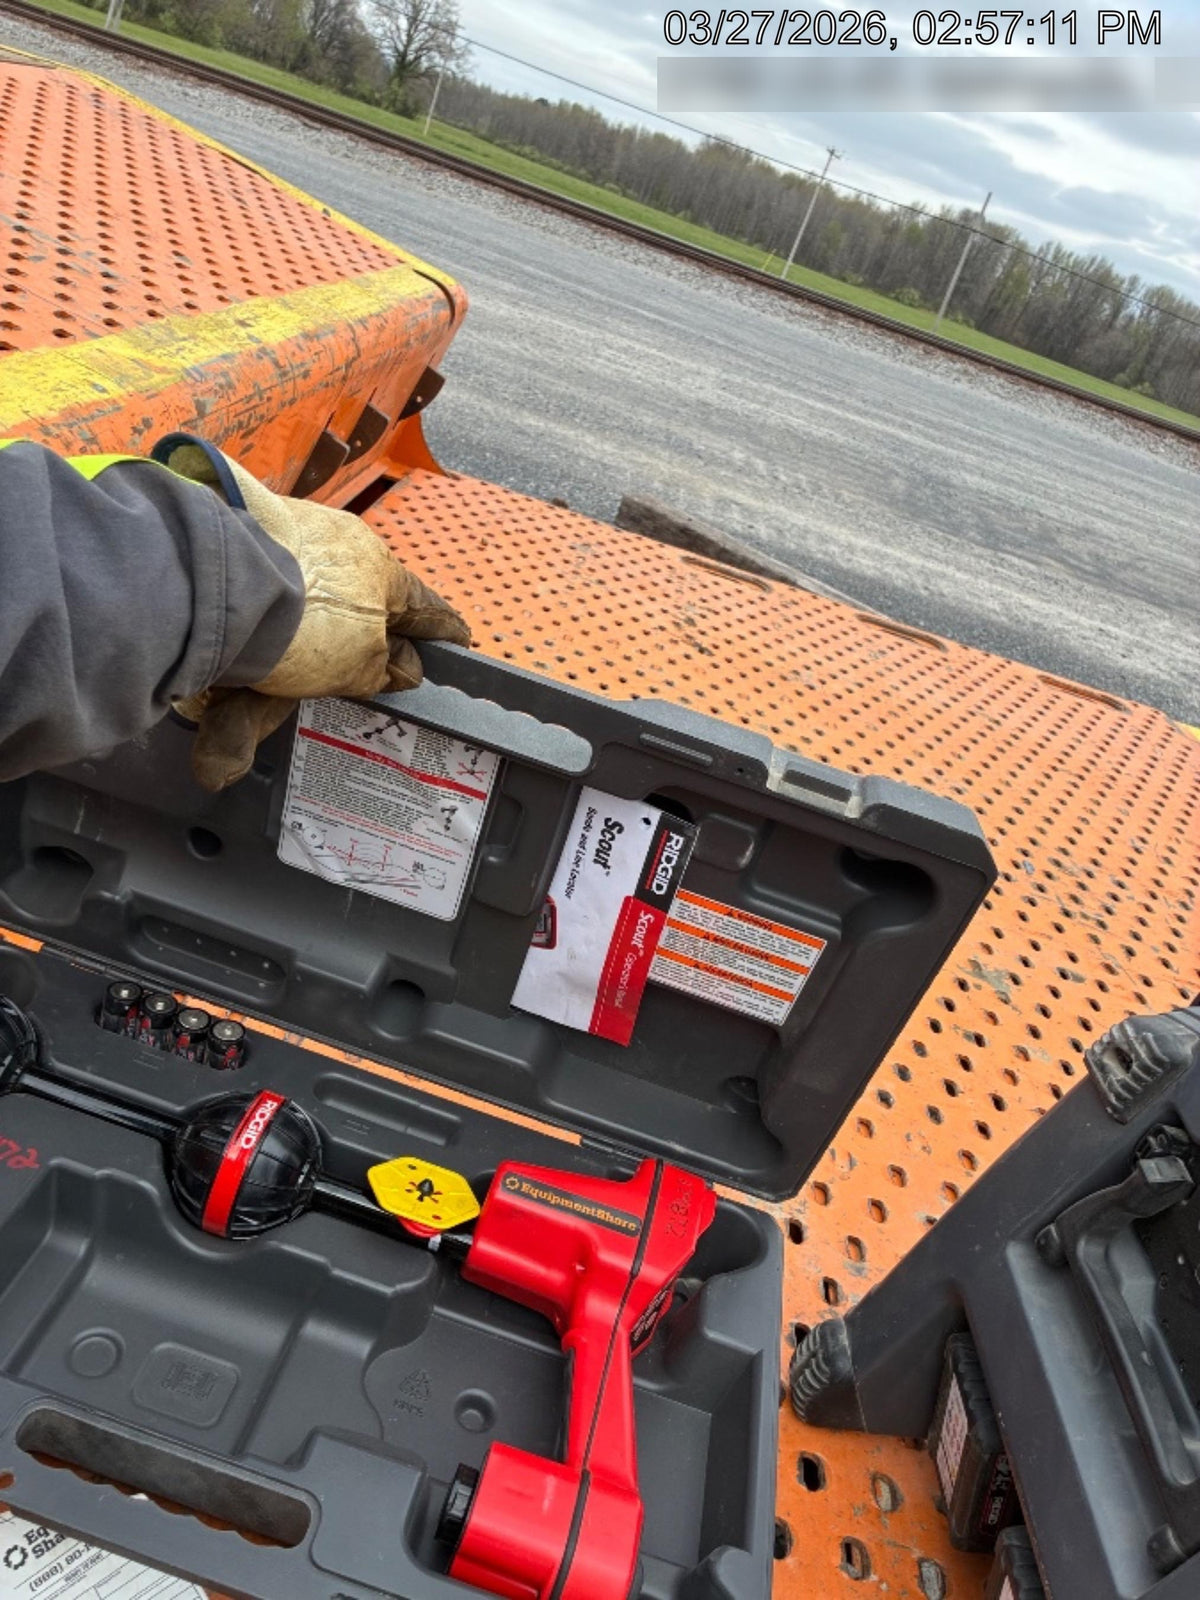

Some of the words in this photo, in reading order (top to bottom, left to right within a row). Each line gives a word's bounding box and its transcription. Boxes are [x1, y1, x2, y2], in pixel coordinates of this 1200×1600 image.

[593, 817, 625, 871] Scout
[653, 831, 685, 895] RIDGID
[631, 911, 655, 949] Scout
[240, 1098, 277, 1150] RIDGID
